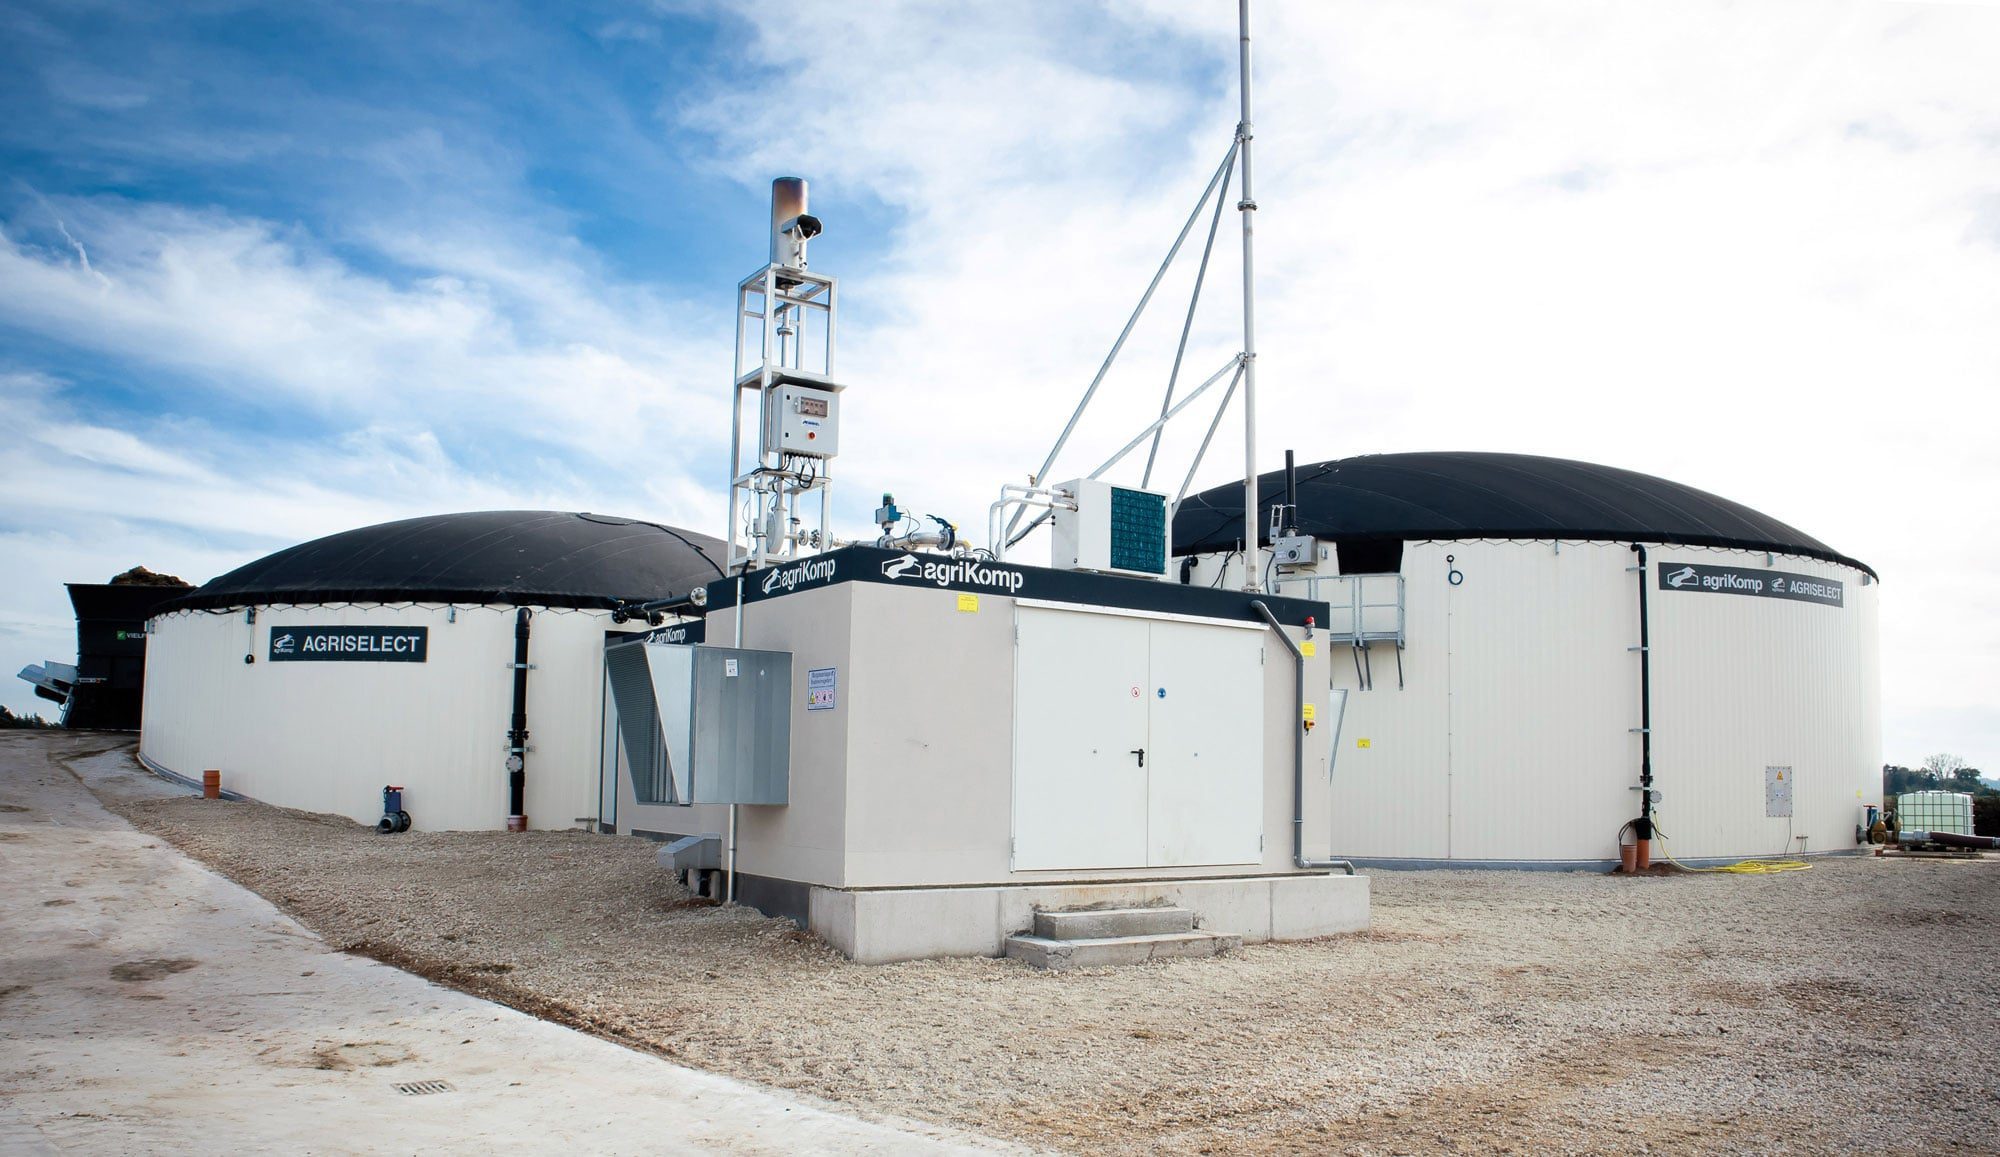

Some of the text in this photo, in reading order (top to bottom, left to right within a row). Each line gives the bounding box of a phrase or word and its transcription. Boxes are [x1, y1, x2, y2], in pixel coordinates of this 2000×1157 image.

[781, 559, 836, 591] agriKomp
[924, 562, 1024, 593] agriKomp
[1703, 574, 1841, 600] agriKomp AGRISELECT
[302, 635, 420, 653] AGRISELECT
